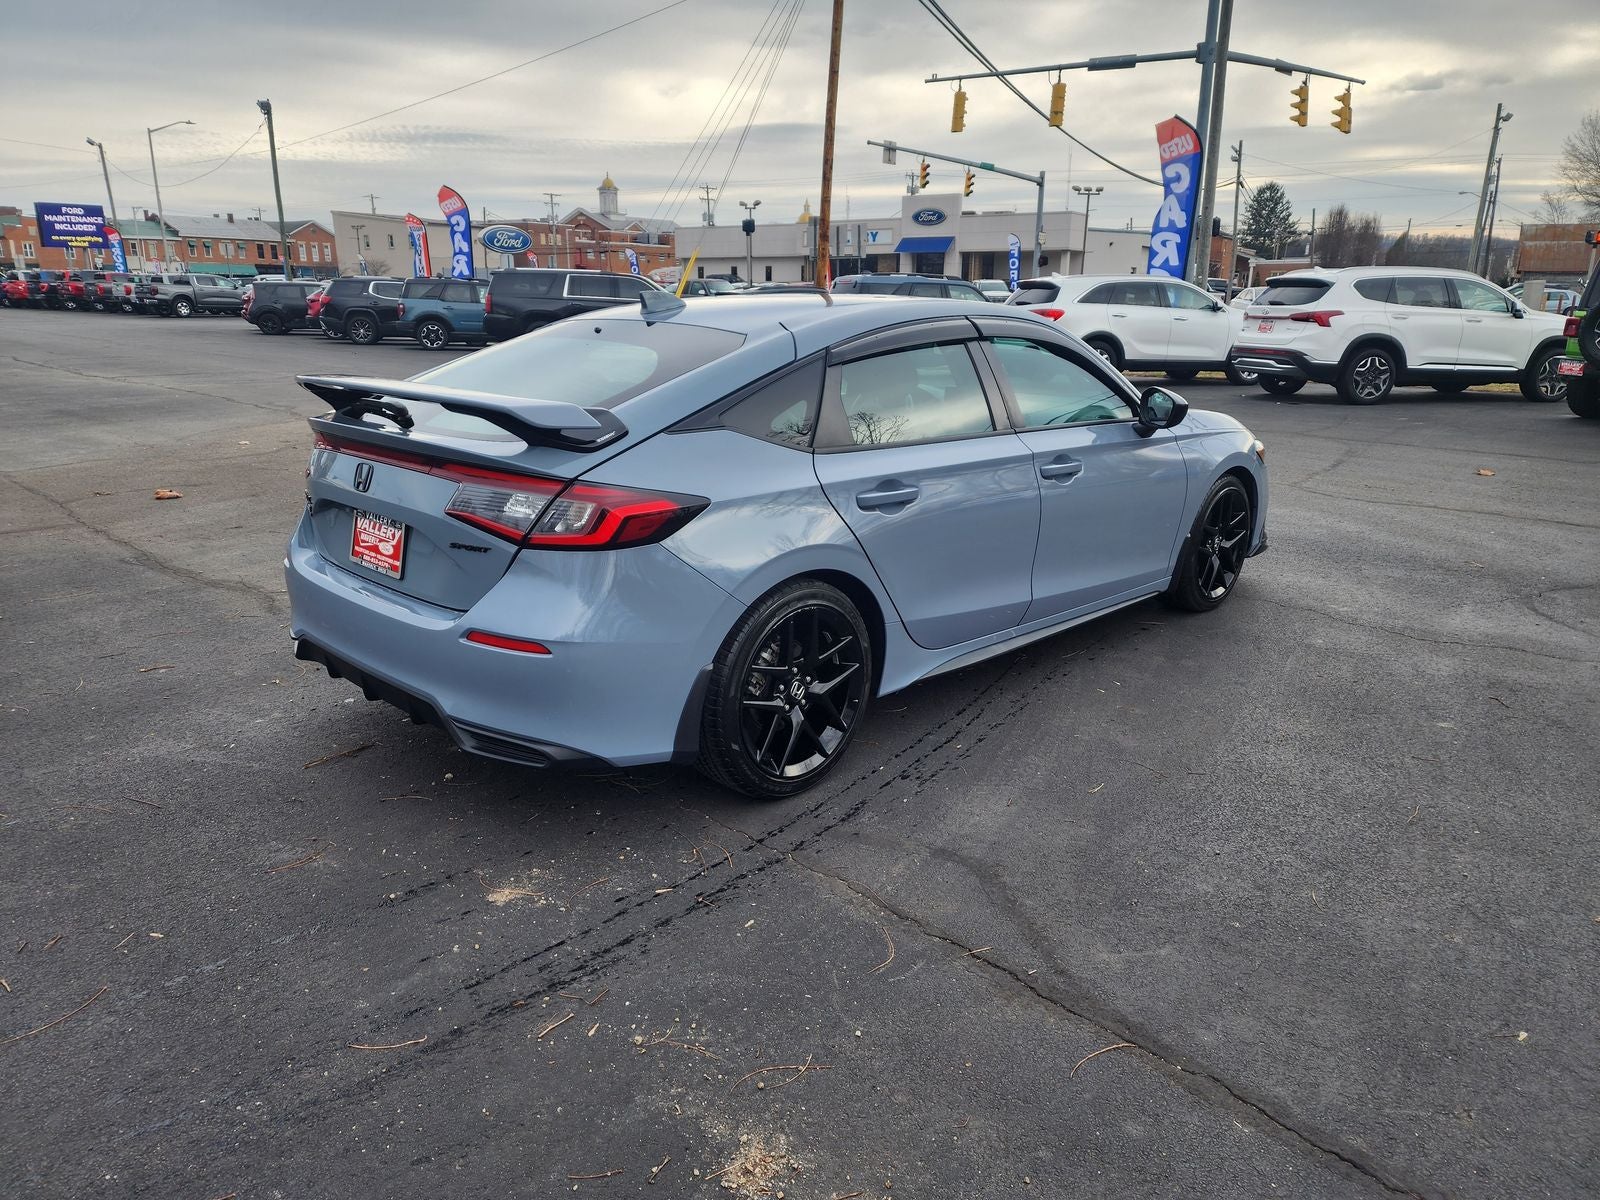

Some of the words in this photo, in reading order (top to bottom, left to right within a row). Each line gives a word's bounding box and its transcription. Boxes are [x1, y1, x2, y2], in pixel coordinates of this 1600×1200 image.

[61, 206, 84, 214] FORD
[44, 214, 103, 223] MAINTENANCE
[919, 211, 938, 221] Ford
[54, 223, 97, 232] INCLUDED!
[494, 230, 523, 247] Ford
[357, 516, 402, 542] VALLERY
[449, 542, 492, 553] SPORT
